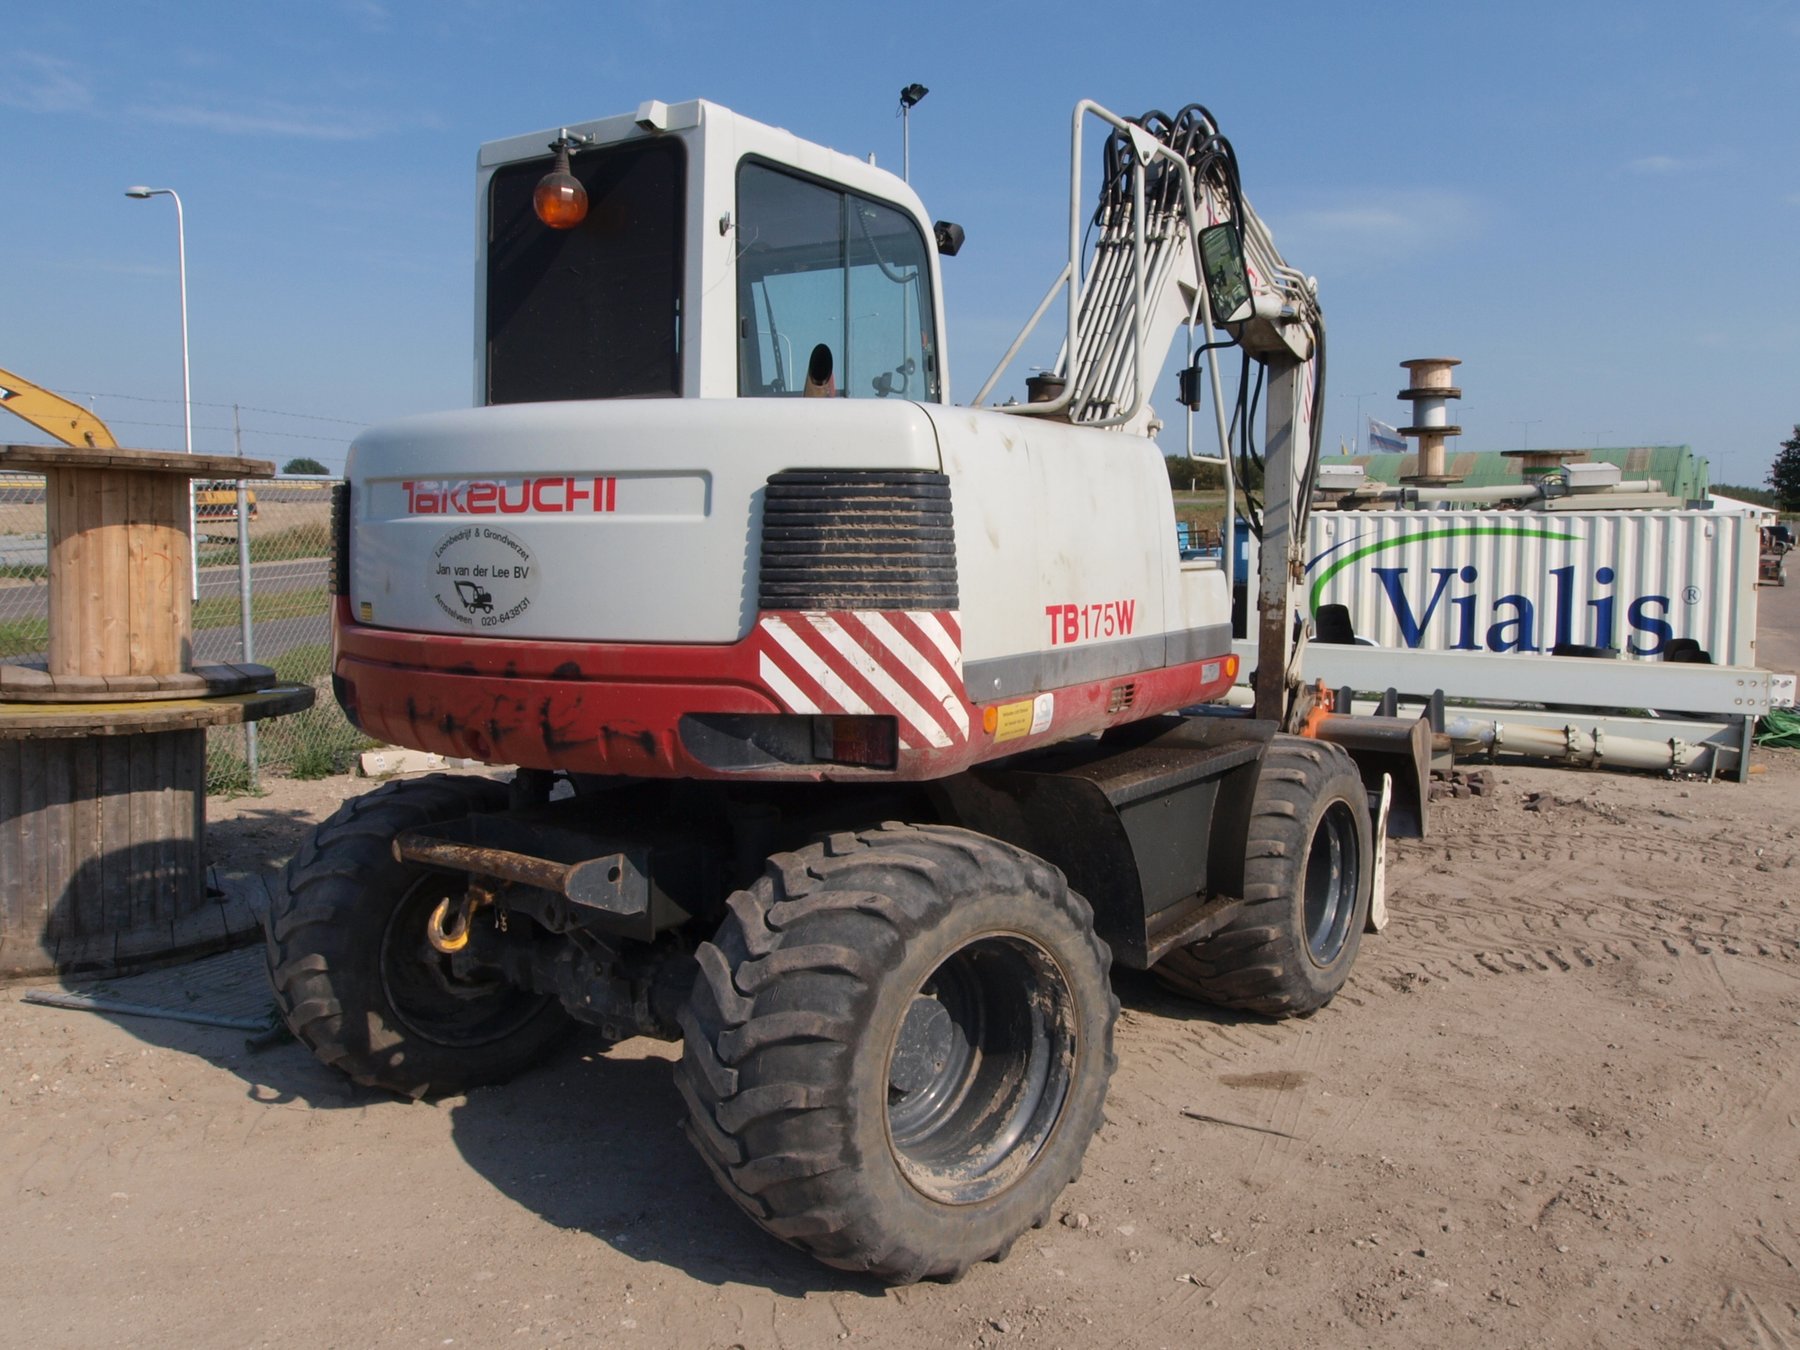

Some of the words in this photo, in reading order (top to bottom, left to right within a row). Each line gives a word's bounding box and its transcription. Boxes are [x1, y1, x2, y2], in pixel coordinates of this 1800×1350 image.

[435, 529, 471, 558] Loonbedrijf
[474, 528, 480, 537] &
[484, 529, 529, 561] Grondverzet
[436, 563, 451, 575] Jan
[454, 566, 469, 576] van
[473, 565, 488, 577] der
[492, 566, 510, 578] Lee
[514, 566, 530, 578] BV
[435, 594, 472, 625] Amstelveen
[482, 597, 530, 626] 020-6438131
[1045, 599, 1135, 645] TB175W
[1372, 565, 1674, 656] Vialis
